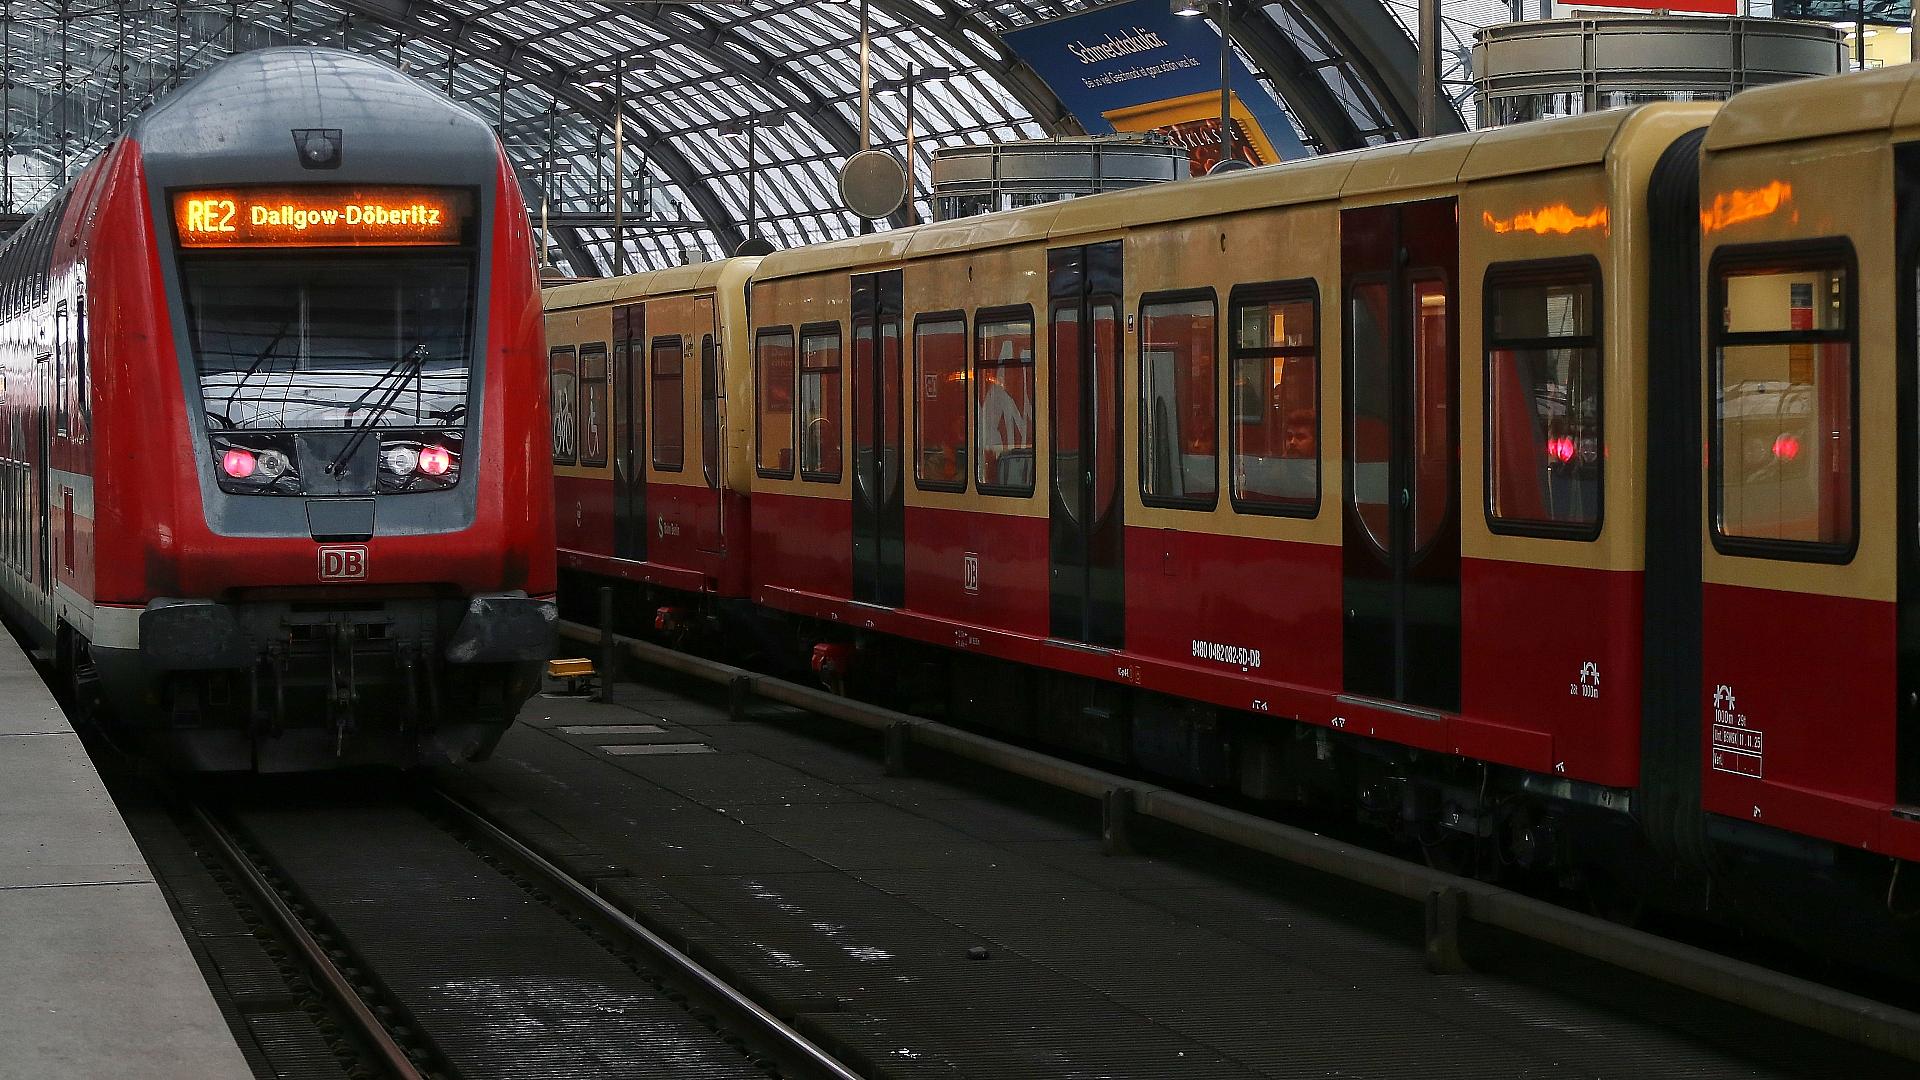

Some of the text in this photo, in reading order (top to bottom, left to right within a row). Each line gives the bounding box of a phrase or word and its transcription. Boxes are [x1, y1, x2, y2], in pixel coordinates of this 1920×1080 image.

[1067, 26, 1168, 64] Schmecktakulär.
[1108, 65, 1142, 83] Geschmack
[188, 200, 441, 232] RE2 Dallgow-Döberitz
[322, 549, 365, 578] DB
[964, 556, 978, 590] DB
[1582, 684, 1599, 699] 1000m
[1715, 709, 1733, 724] 1000m
